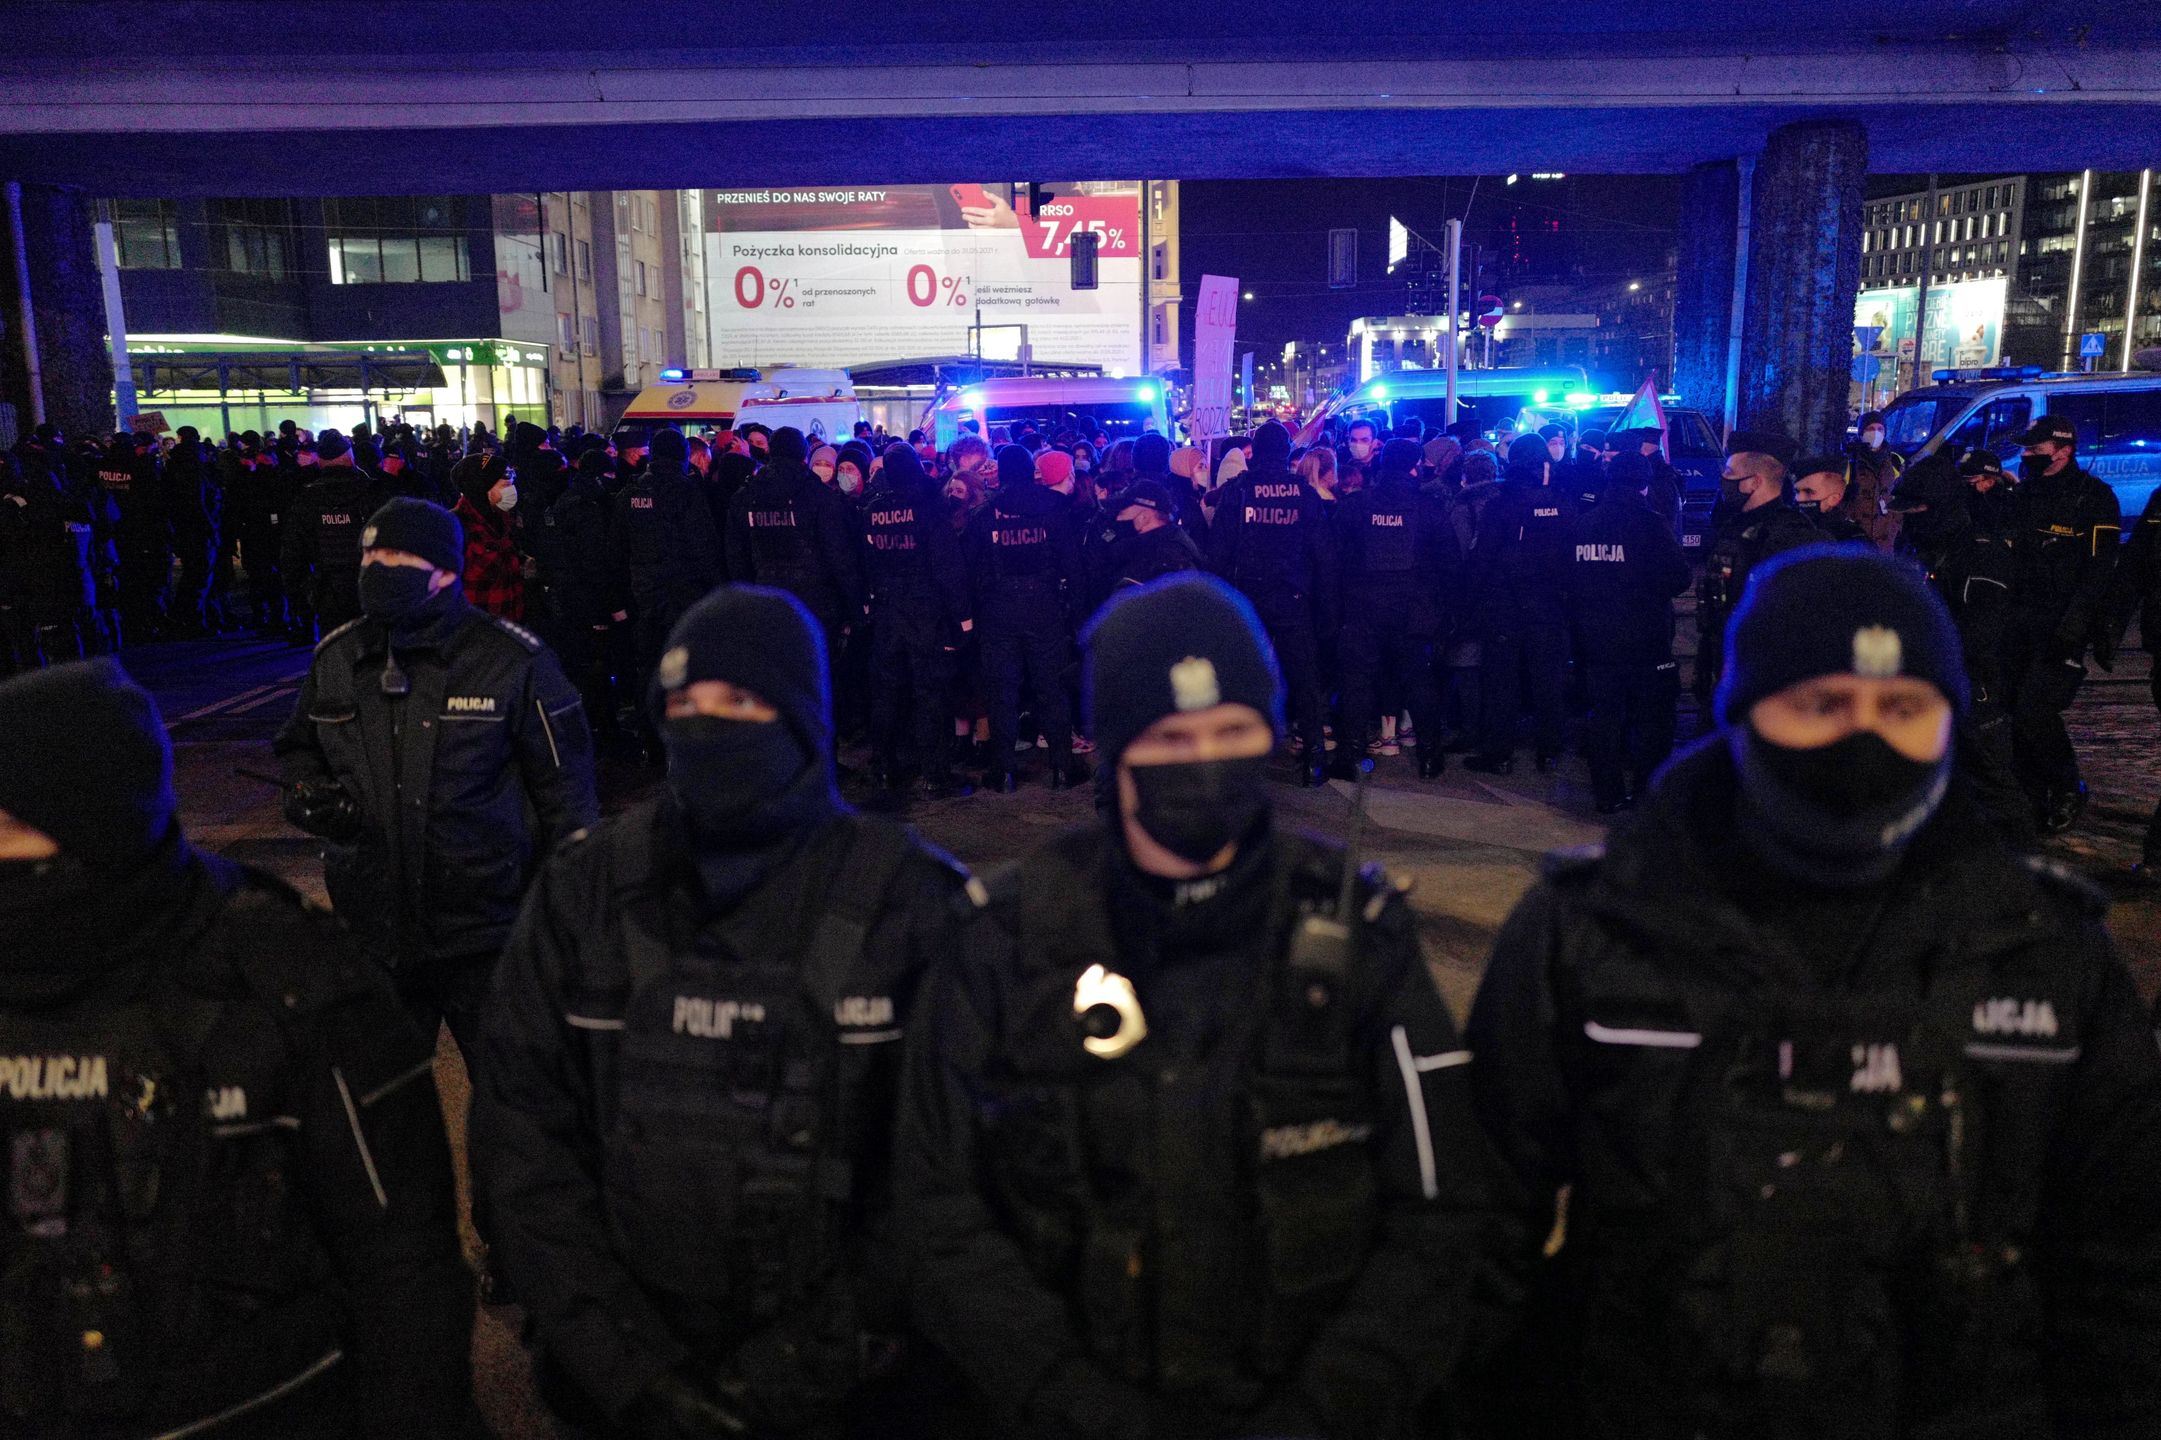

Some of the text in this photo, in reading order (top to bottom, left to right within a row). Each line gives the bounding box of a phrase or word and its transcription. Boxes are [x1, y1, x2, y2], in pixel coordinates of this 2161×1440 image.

[717, 190, 886, 204] PRZENIEŚ DO NAS SWOJE RATY
[1040, 204, 1074, 216] RRSO
[733, 243, 898, 260] Pożyczka konsolidacyjna
[814, 288, 876, 298] przenoszonych
[98, 470, 132, 482] POLICJA
[1254, 483, 1301, 499] POLICJA
[630, 496, 653, 509] POLICJA
[322, 513, 352, 525] POLICJA
[871, 508, 915, 526] POLICJA
[1244, 506, 1300, 526] POLICJA
[1533, 507, 1559, 518] POLICJA
[1371, 513, 1404, 527] POLICJA
[1575, 544, 1626, 563] POLICJA
[447, 696, 497, 712] POLICJA
